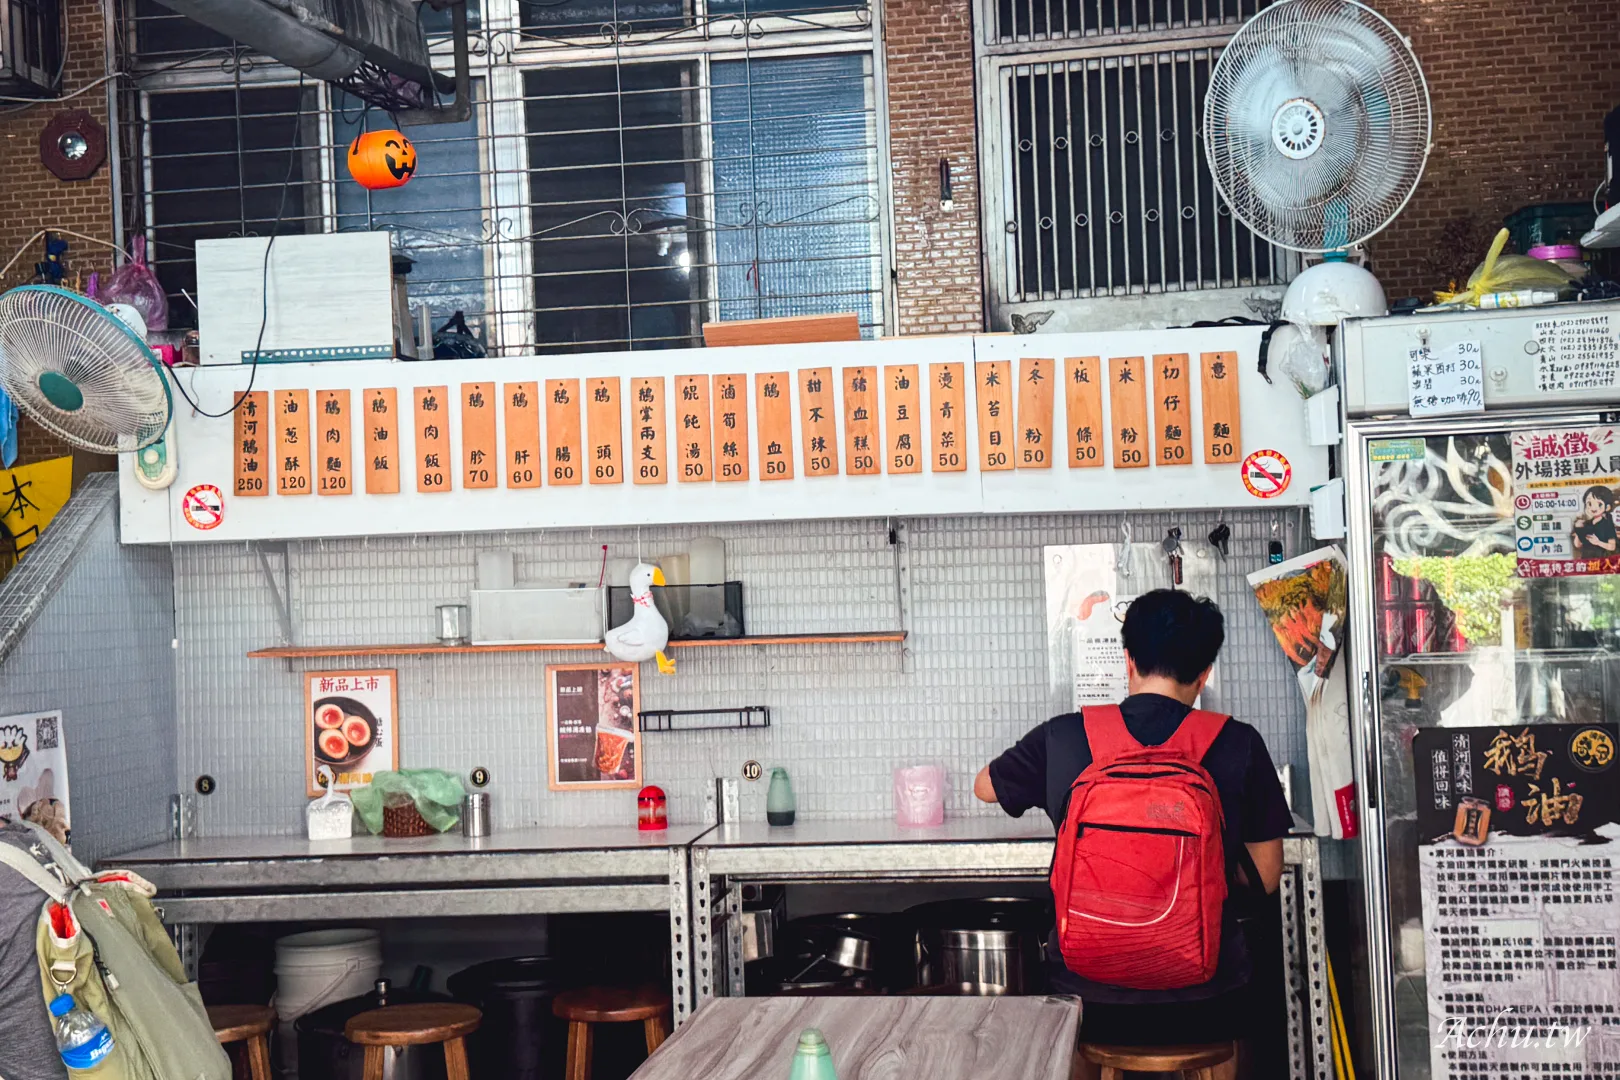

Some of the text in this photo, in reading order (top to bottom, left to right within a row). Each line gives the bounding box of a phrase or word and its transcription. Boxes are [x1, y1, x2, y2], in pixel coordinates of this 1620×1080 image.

[237, 399, 264, 492] 清河鵝油 250
[323, 399, 347, 490] 鵝肉麵 120
[371, 398, 391, 471] 鵝油飯
[422, 395, 444, 487] 鵝肉飯 80
[468, 392, 490, 484] 鵝胗 70
[511, 391, 534, 484] 鵝肝 60
[553, 388, 575, 480] 鵝腸 60
[594, 386, 616, 479] 鵝頭 60
[638, 386, 660, 479] 鵝掌兩支 60
[682, 384, 705, 477] 餛飩湯 50
[721, 383, 743, 477] 滷筍絲 50
[763, 381, 787, 475] 鵝血 50
[806, 378, 832, 472] 甜不辣 50
[895, 375, 915, 469] 油豆腐 50
[939, 371, 960, 467] 燙青菜 50
[985, 370, 1008, 467] 米苔目 50
[1024, 368, 1045, 464] 冬粉 50
[1073, 368, 1097, 462] 板條 50
[1118, 367, 1143, 464] 米粉 50
[1161, 366, 1186, 461] 切仔麵 50
[1210, 361, 1234, 458] 意麵 50
[1531, 432, 1590, 458] 誠徵
[281, 476, 307, 490] 120
[855, 456, 874, 470] 50
[1515, 455, 1620, 480] 外場接單人員
[1534, 499, 1577, 509] 06:00-14:00
[319, 677, 380, 693] 新品上市
[744, 764, 759, 778] 10
[1432, 734, 1472, 810] 清河美味 值得回味
